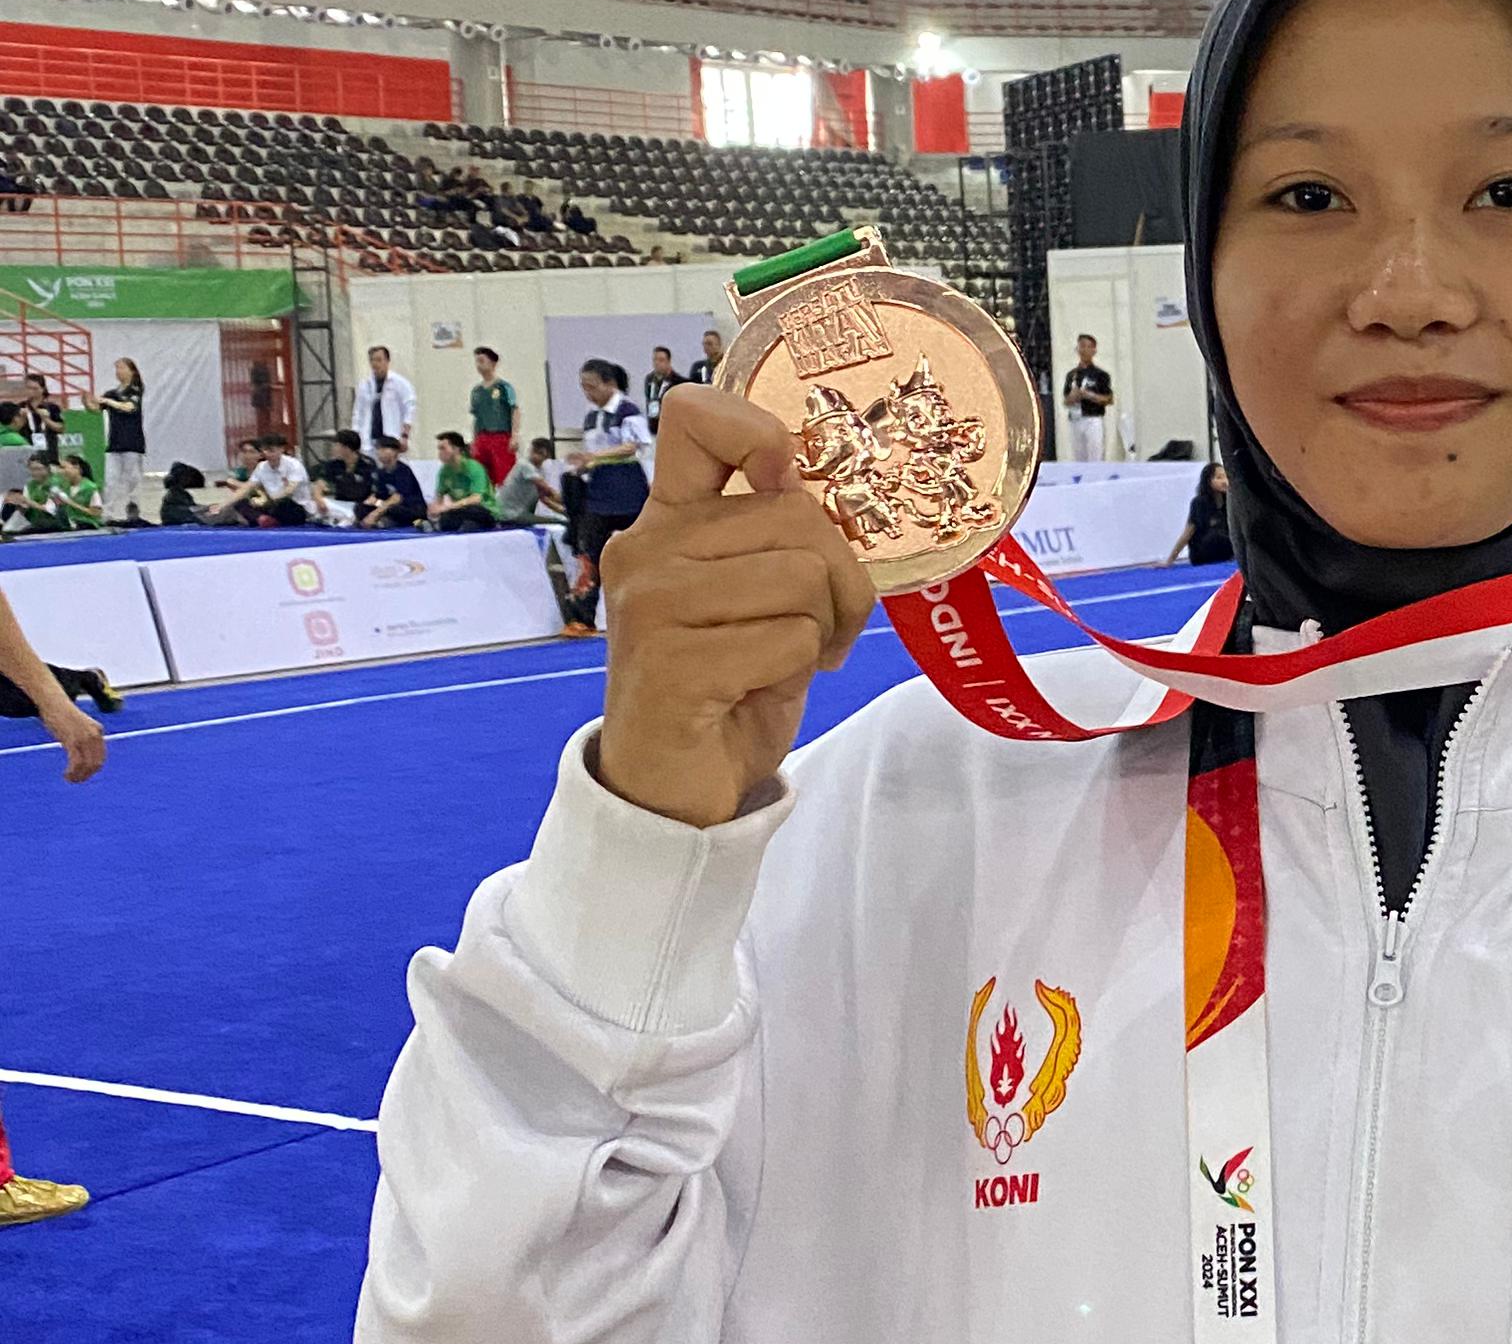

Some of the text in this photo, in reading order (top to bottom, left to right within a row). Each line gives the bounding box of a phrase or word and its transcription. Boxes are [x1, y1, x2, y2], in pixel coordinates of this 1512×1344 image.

[975, 1173, 1039, 1208] KONI
[1202, 1254, 1214, 1290] 2024
[1216, 1224, 1229, 1318] ACEH-SUMUT
[1238, 1223, 1258, 1317] PON XXI
